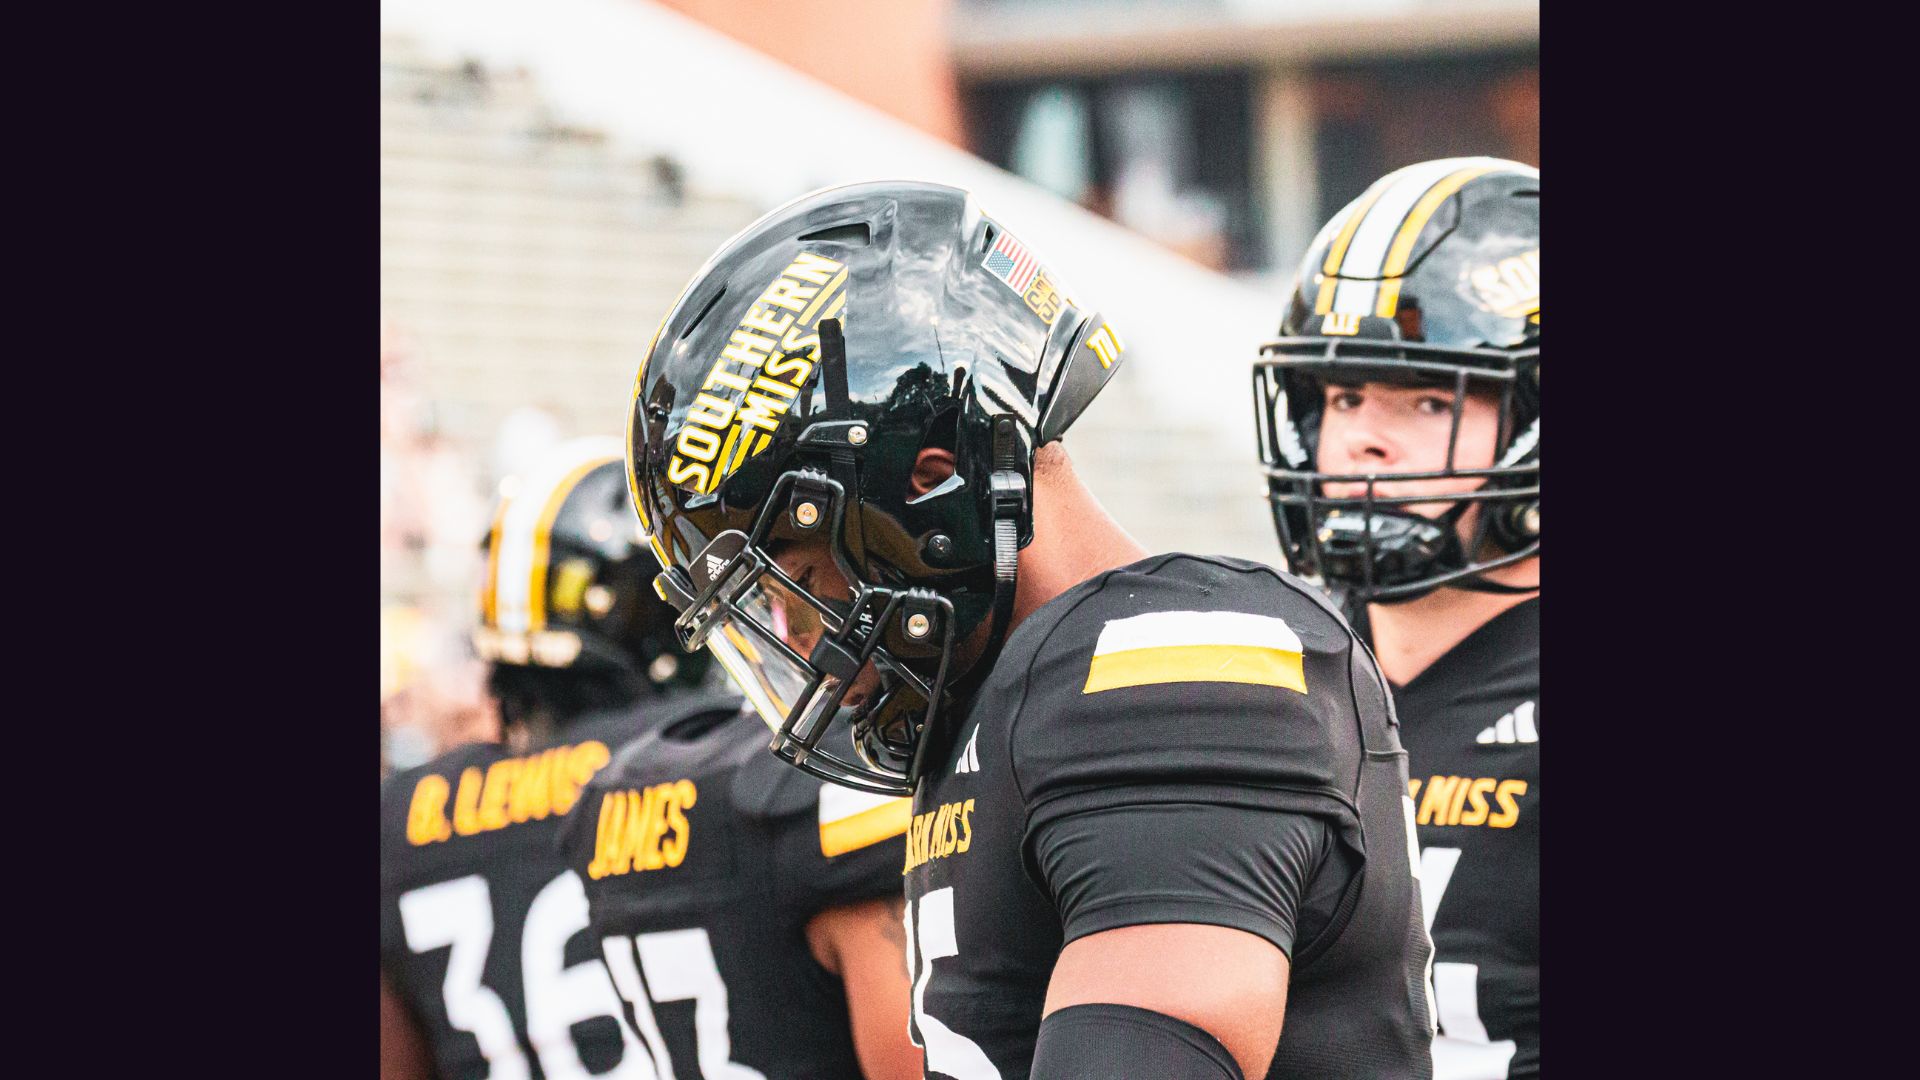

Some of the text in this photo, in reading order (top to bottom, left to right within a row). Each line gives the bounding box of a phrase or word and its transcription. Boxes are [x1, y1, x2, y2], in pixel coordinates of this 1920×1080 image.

[667, 252, 843, 494] SOUTHERN
[735, 326, 822, 431] MISS
[587, 778, 697, 880] JAMES
[929, 798, 976, 859] MISS
[1416, 775, 1528, 828] MISS
[399, 869, 658, 1080] 36
